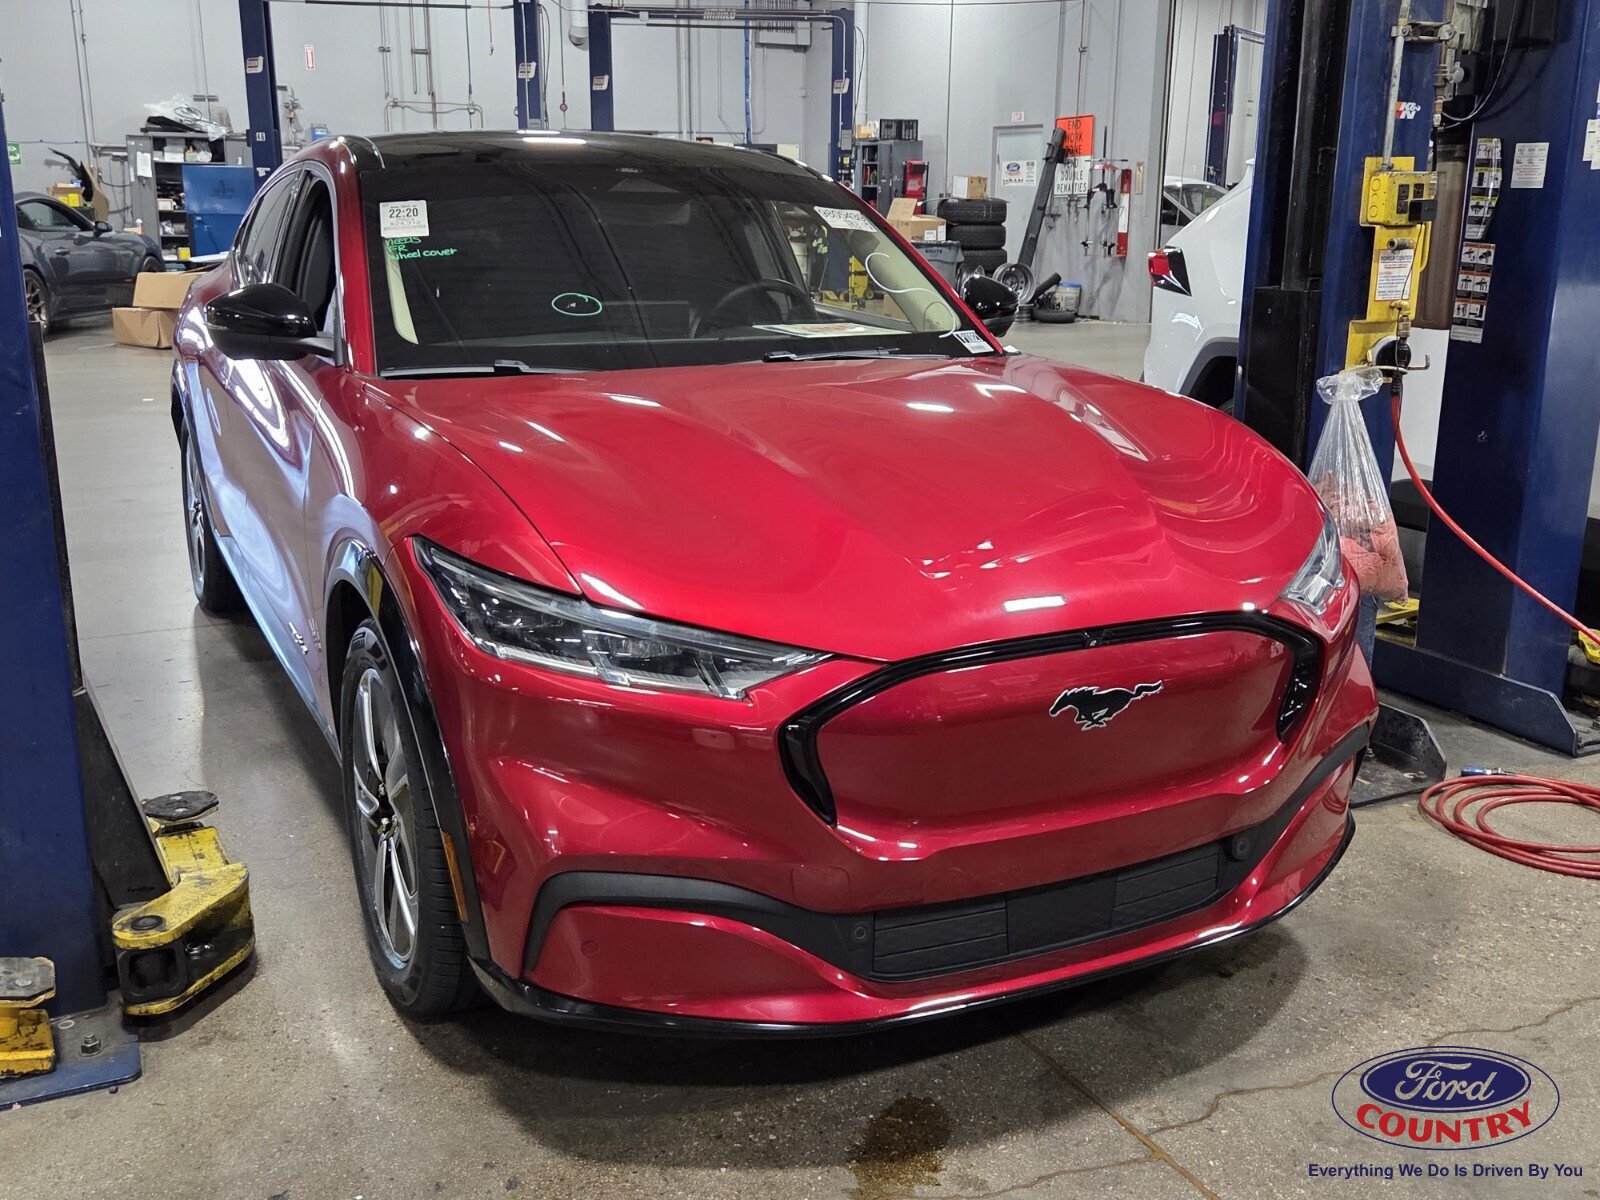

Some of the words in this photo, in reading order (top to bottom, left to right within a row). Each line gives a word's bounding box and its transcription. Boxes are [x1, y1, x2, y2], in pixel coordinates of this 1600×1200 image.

[1061, 170, 1083, 180] DOULE
[1057, 183, 1086, 192] PENATIES
[389, 208, 418, 218] 22:20
[422, 248, 458, 257] cover
